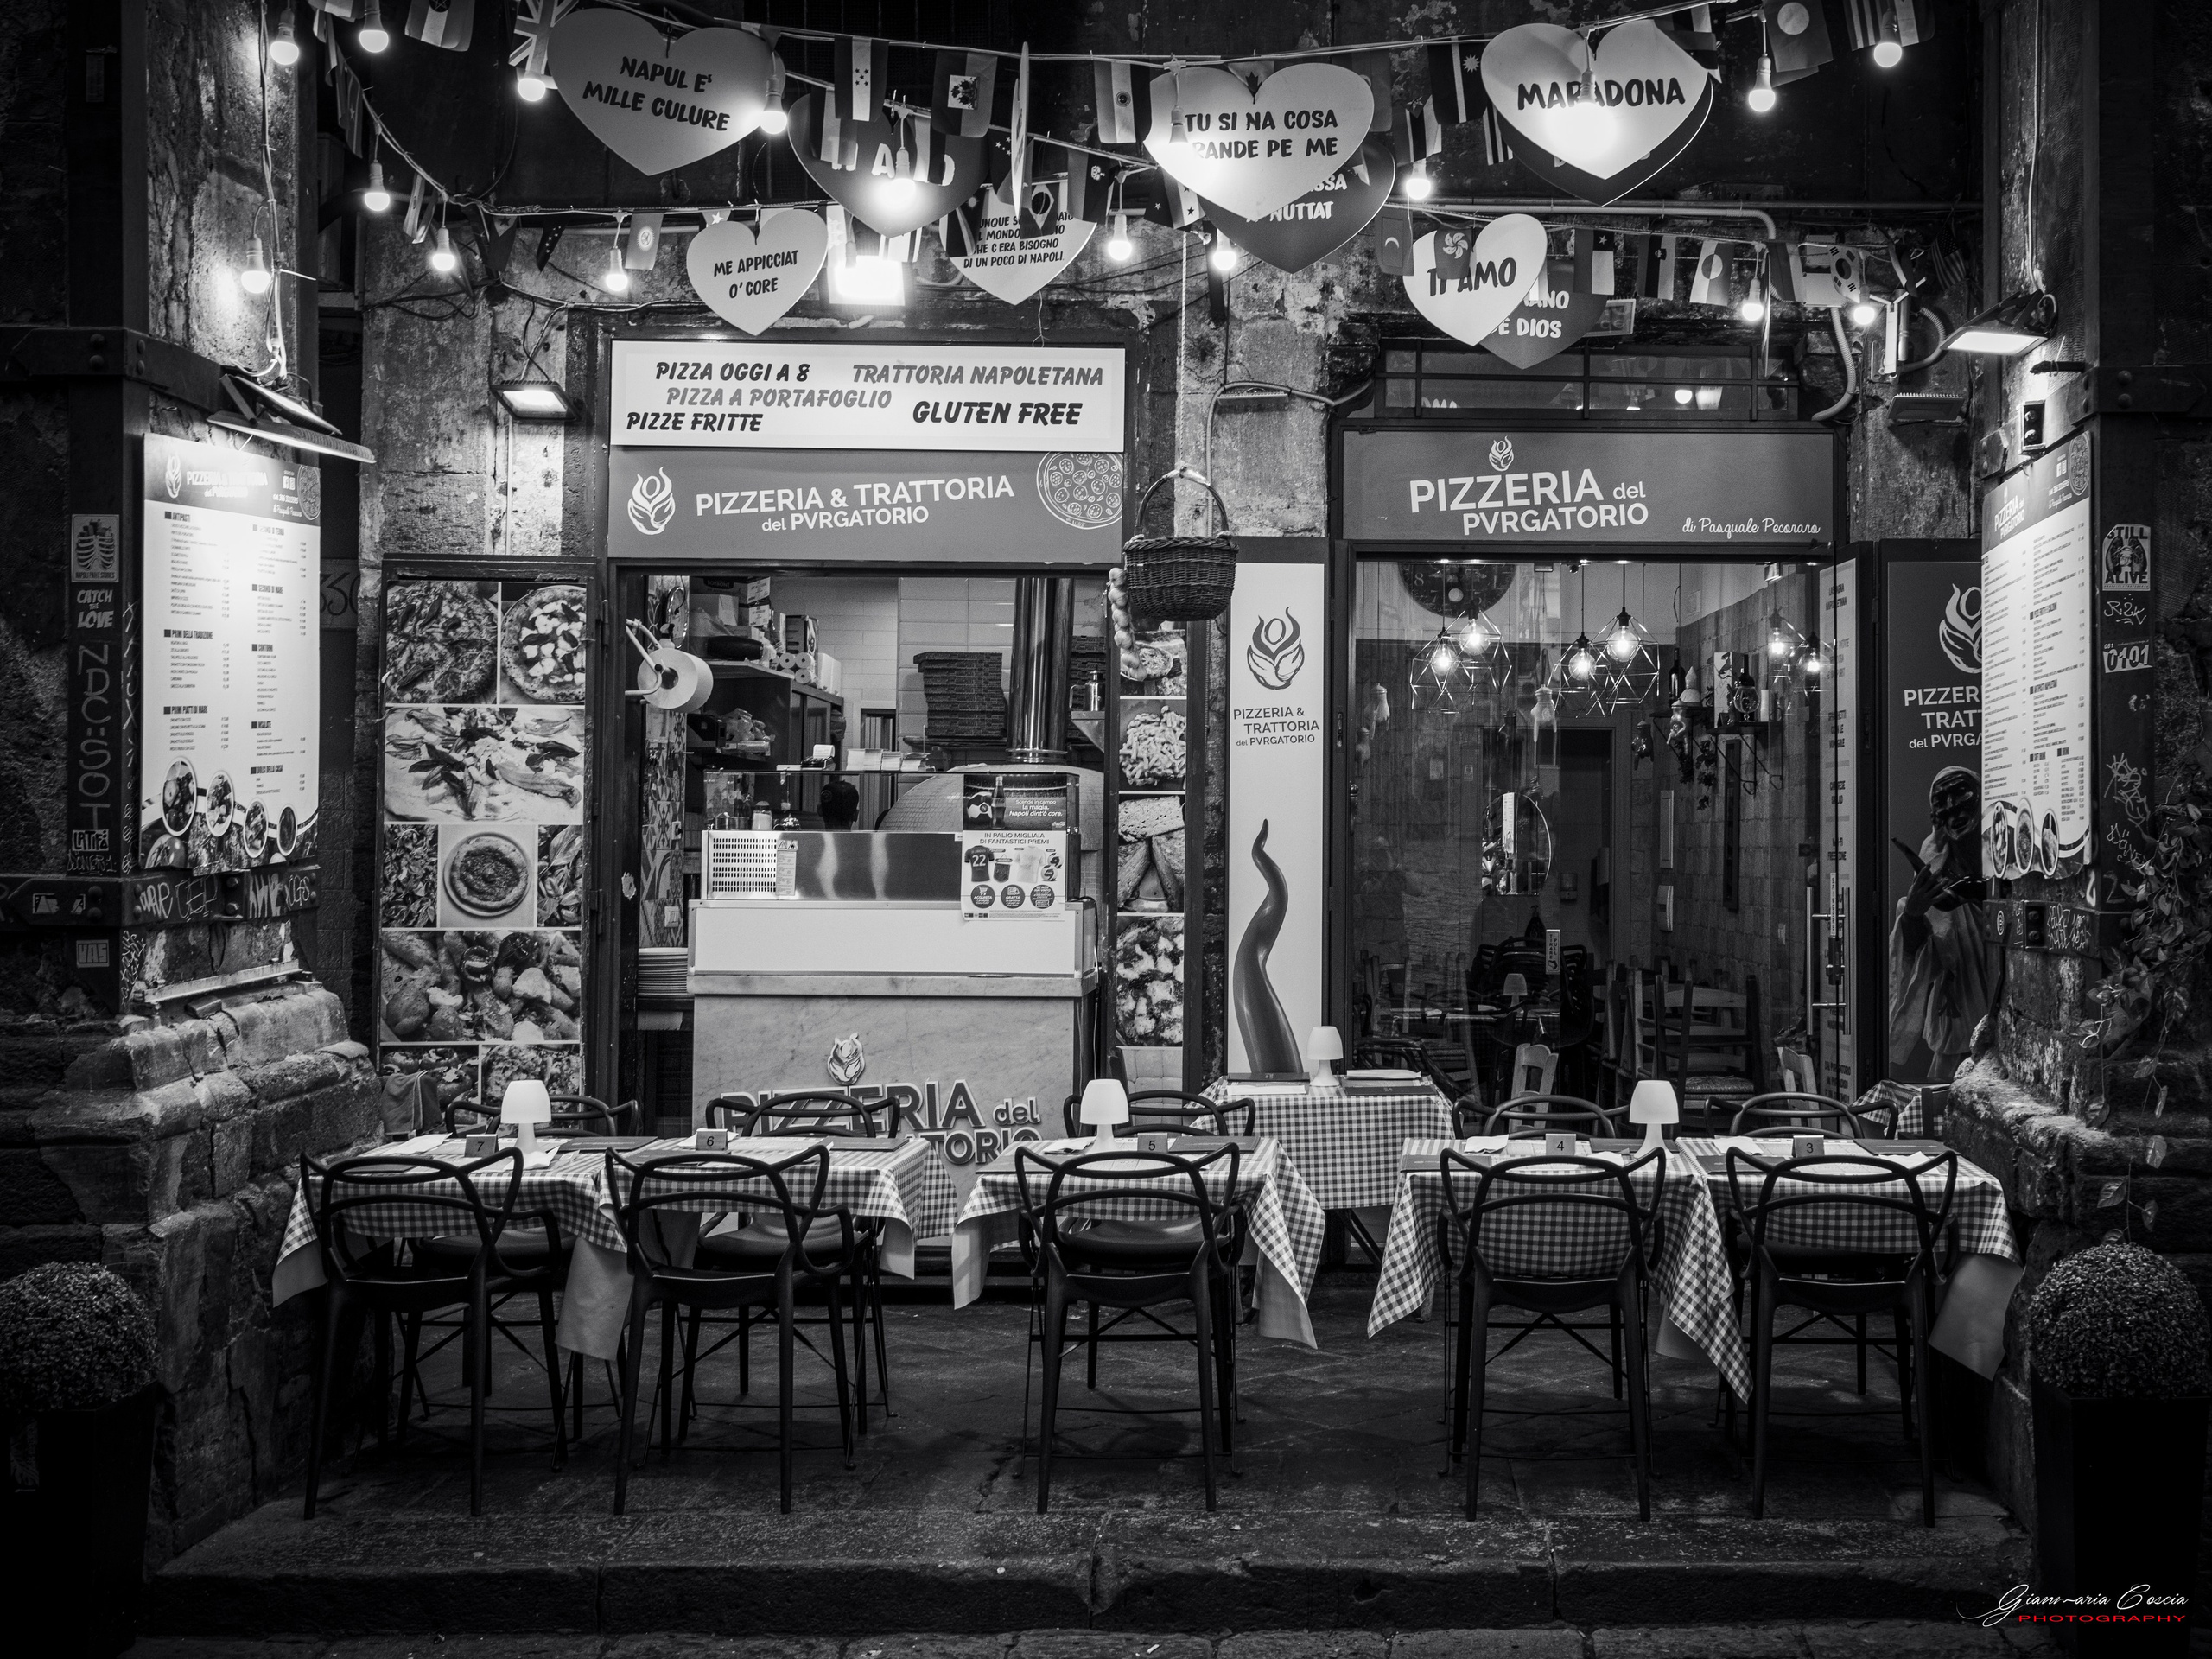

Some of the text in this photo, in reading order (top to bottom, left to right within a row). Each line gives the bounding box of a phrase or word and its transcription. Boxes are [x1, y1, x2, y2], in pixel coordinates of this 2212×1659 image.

[620, 56, 688, 88] NAPUL
[582, 81, 730, 130] MILLE CULURE
[1185, 109, 1338, 132] TU SI NA COSA
[1192, 137, 1338, 159] RANDE PE ME
[1020, 238, 1059, 251] BISOGNO
[714, 250, 798, 277] ME APPICCIAT
[963, 258, 973, 268] DI
[976, 257, 988, 267] UN
[991, 255, 1015, 266] POCO
[1018, 254, 1027, 264] DI
[1457, 257, 1517, 293] AMO
[746, 277, 779, 296] CORE
[1516, 318, 1562, 339] DIOS
[655, 361, 810, 382] PIZZA OGGI A 8
[853, 364, 1103, 385] TRATTORIA NAPOLETANA
[666, 387, 892, 409] PIZZA A PORTAFOGLIO
[626, 411, 763, 433] PIZZE FRITTE
[912, 400, 1084, 426] GLUTEN FREE
[696, 474, 1015, 517] PIZZERIA & TRATTORIA
[1409, 467, 1646, 513] PIZZERIA del
[761, 505, 930, 532] del PVRGATORIO
[1463, 501, 1649, 537] PVRGATORIO
[1681, 517, 1821, 540] di Pasquale Pecoraro
[2107, 526, 2149, 540] STILL
[2105, 571, 2149, 584] ALIVE
[76, 589, 113, 604] CATCH
[77, 610, 114, 629] LOVE
[2105, 645, 2150, 671] 0101
[1233, 706, 1306, 720] PIZZERIA &
[1244, 720, 1319, 734] TRATTORIA
[1236, 734, 1315, 747] del PVRGATORIO
[1909, 738, 1929, 749] del
[972, 854, 987, 867] 22
[993, 1097, 1041, 1125] del
[476, 1141, 484, 1153] 7
[706, 1135, 715, 1147] 6
[1148, 1139, 1156, 1151] 5
[1556, 1140, 1565, 1151] 4
[1806, 1142, 1814, 1154] 3
